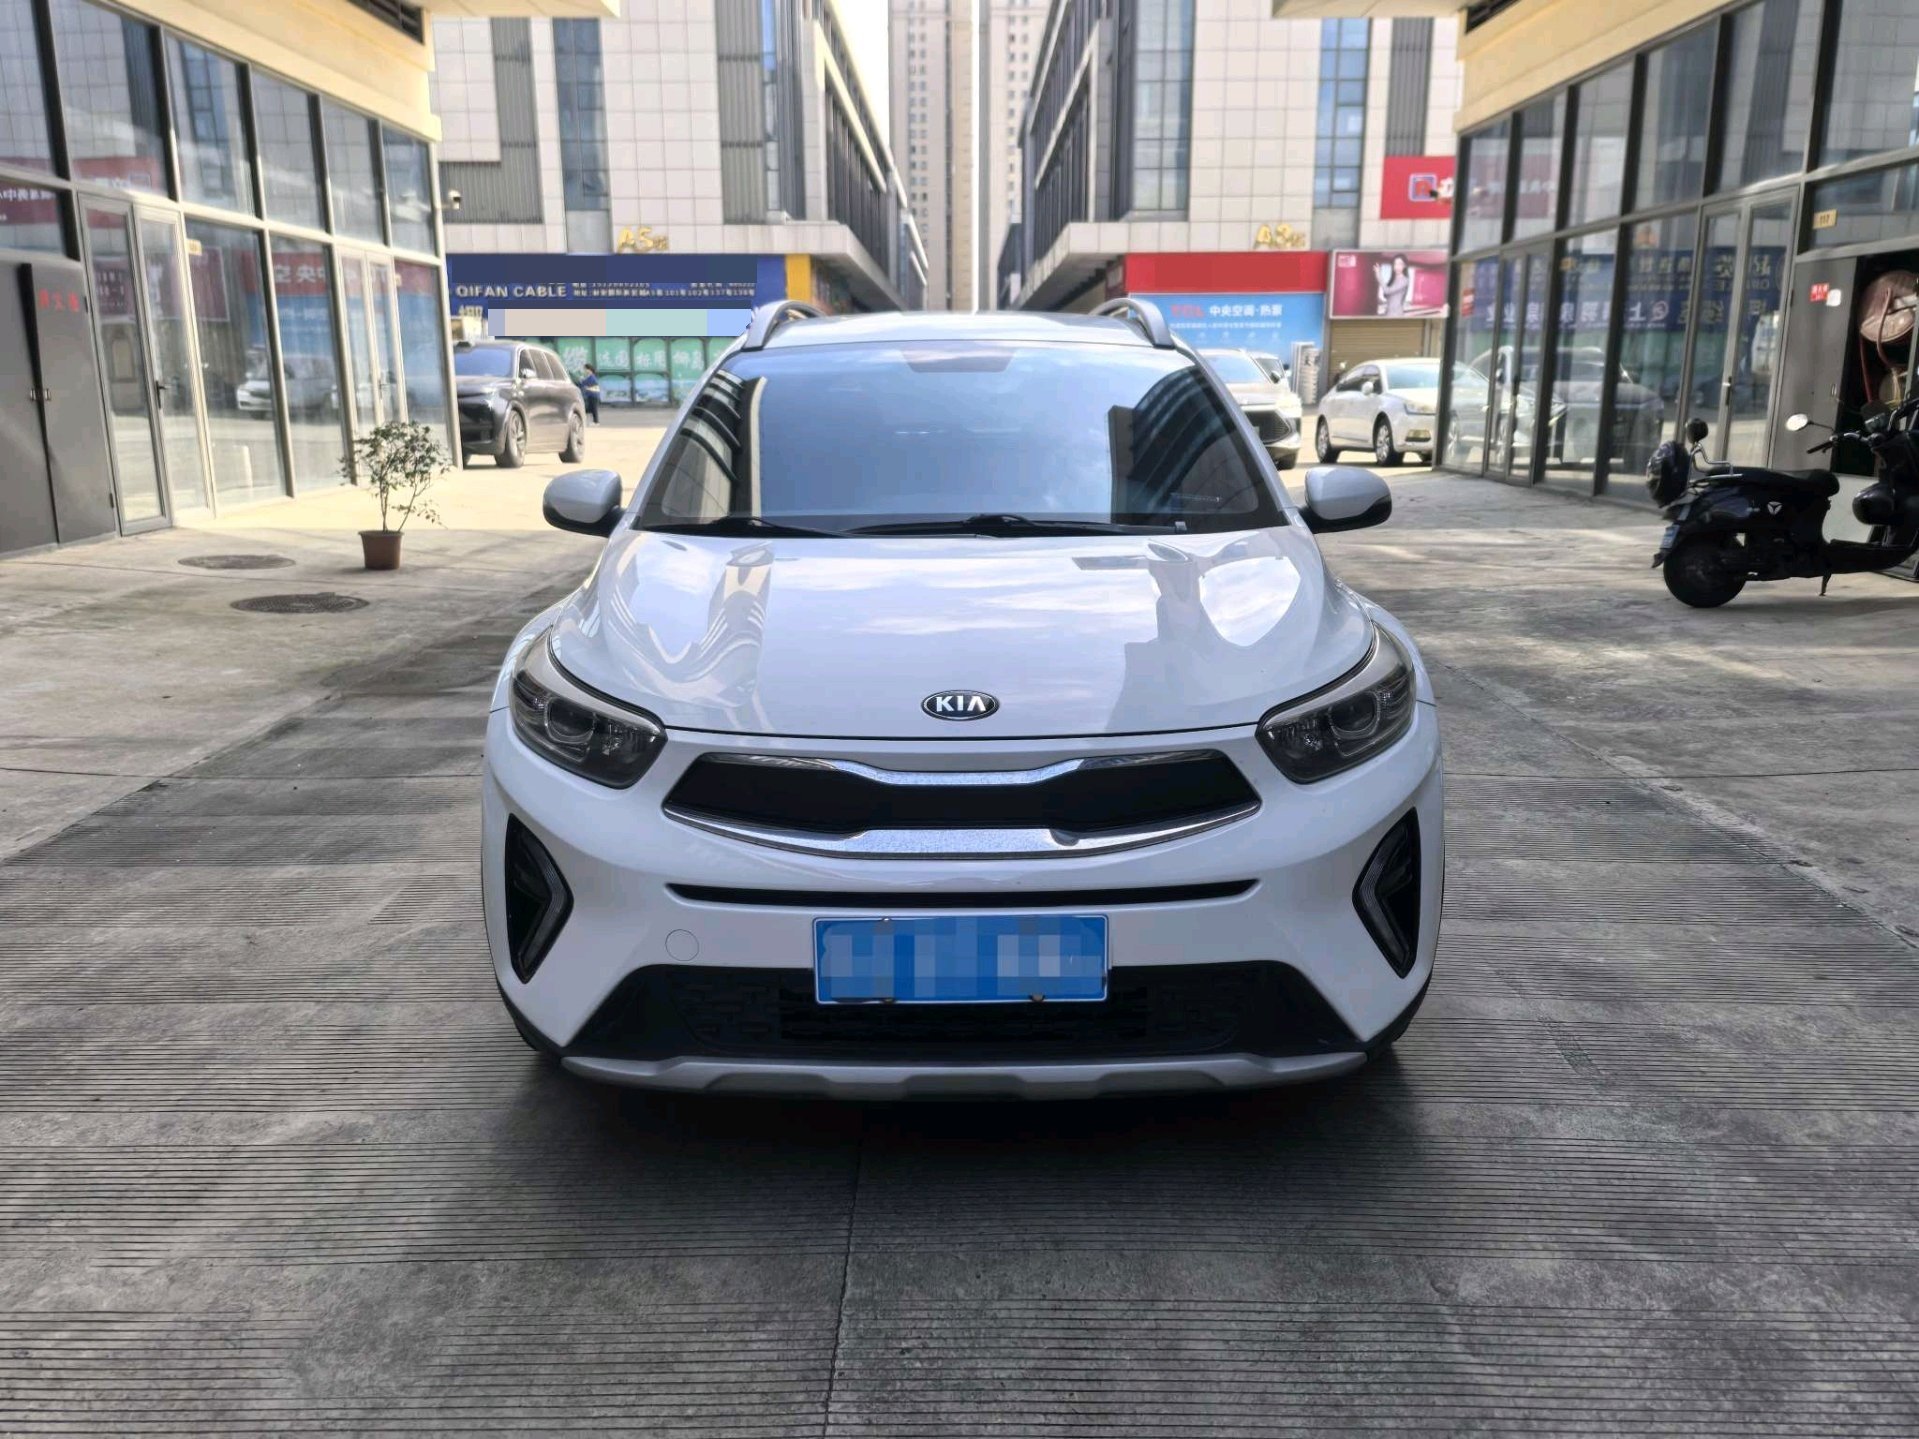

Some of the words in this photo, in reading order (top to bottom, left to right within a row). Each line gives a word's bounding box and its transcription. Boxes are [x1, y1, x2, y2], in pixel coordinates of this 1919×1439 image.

[456, 285, 508, 298] QIFAN
[513, 285, 567, 298] CABLE
[936, 695, 987, 712] KIA
